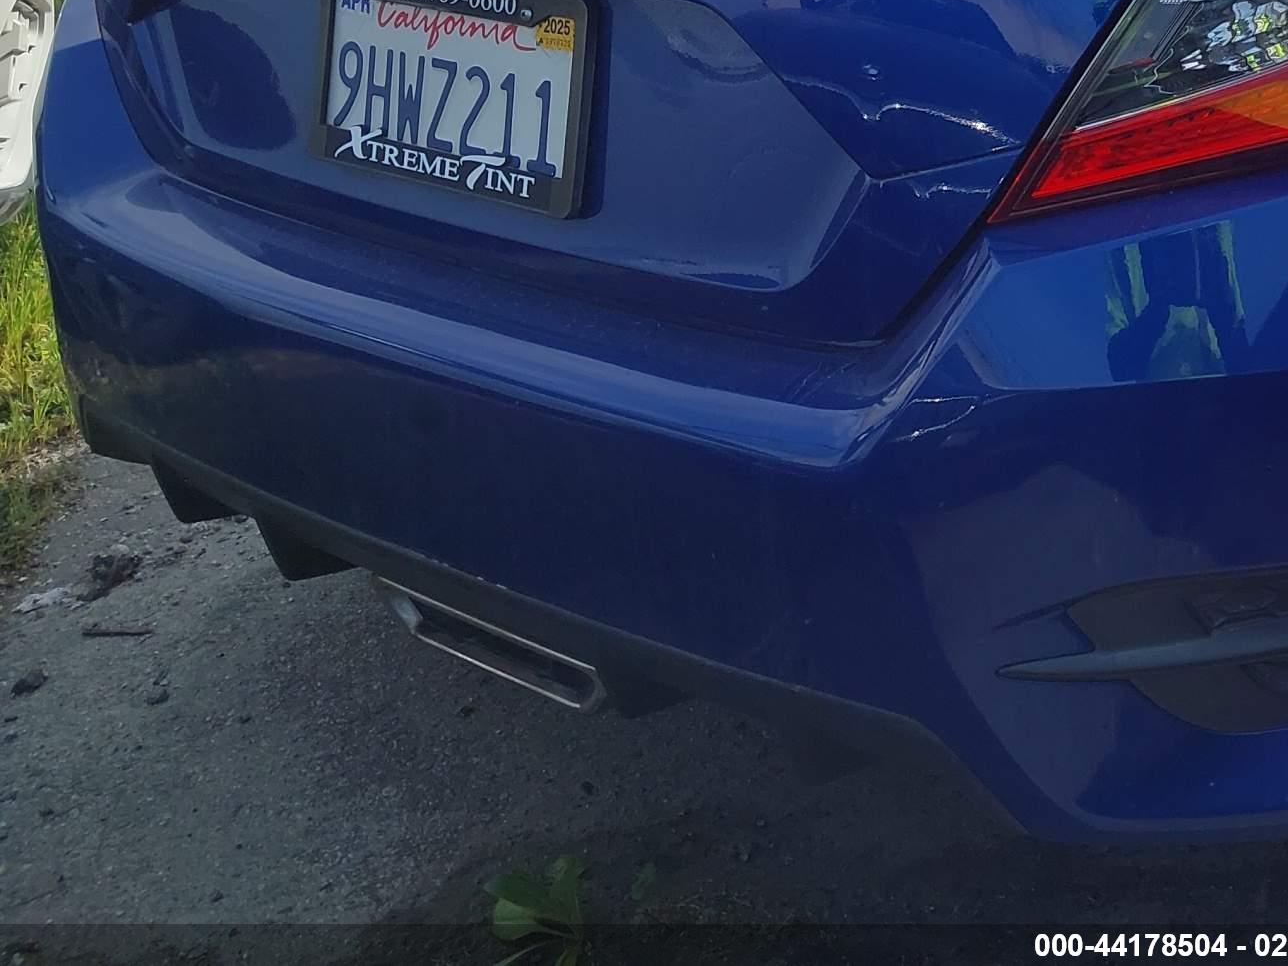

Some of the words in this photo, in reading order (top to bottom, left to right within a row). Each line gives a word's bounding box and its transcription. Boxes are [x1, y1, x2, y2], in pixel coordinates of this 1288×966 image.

[377, 0, 536, 51] California
[543, 18, 570, 36] 2025
[333, 41, 556, 177] 9HWZ211
[334, 125, 460, 181] XTREME
[459, 154, 535, 198] TINT
